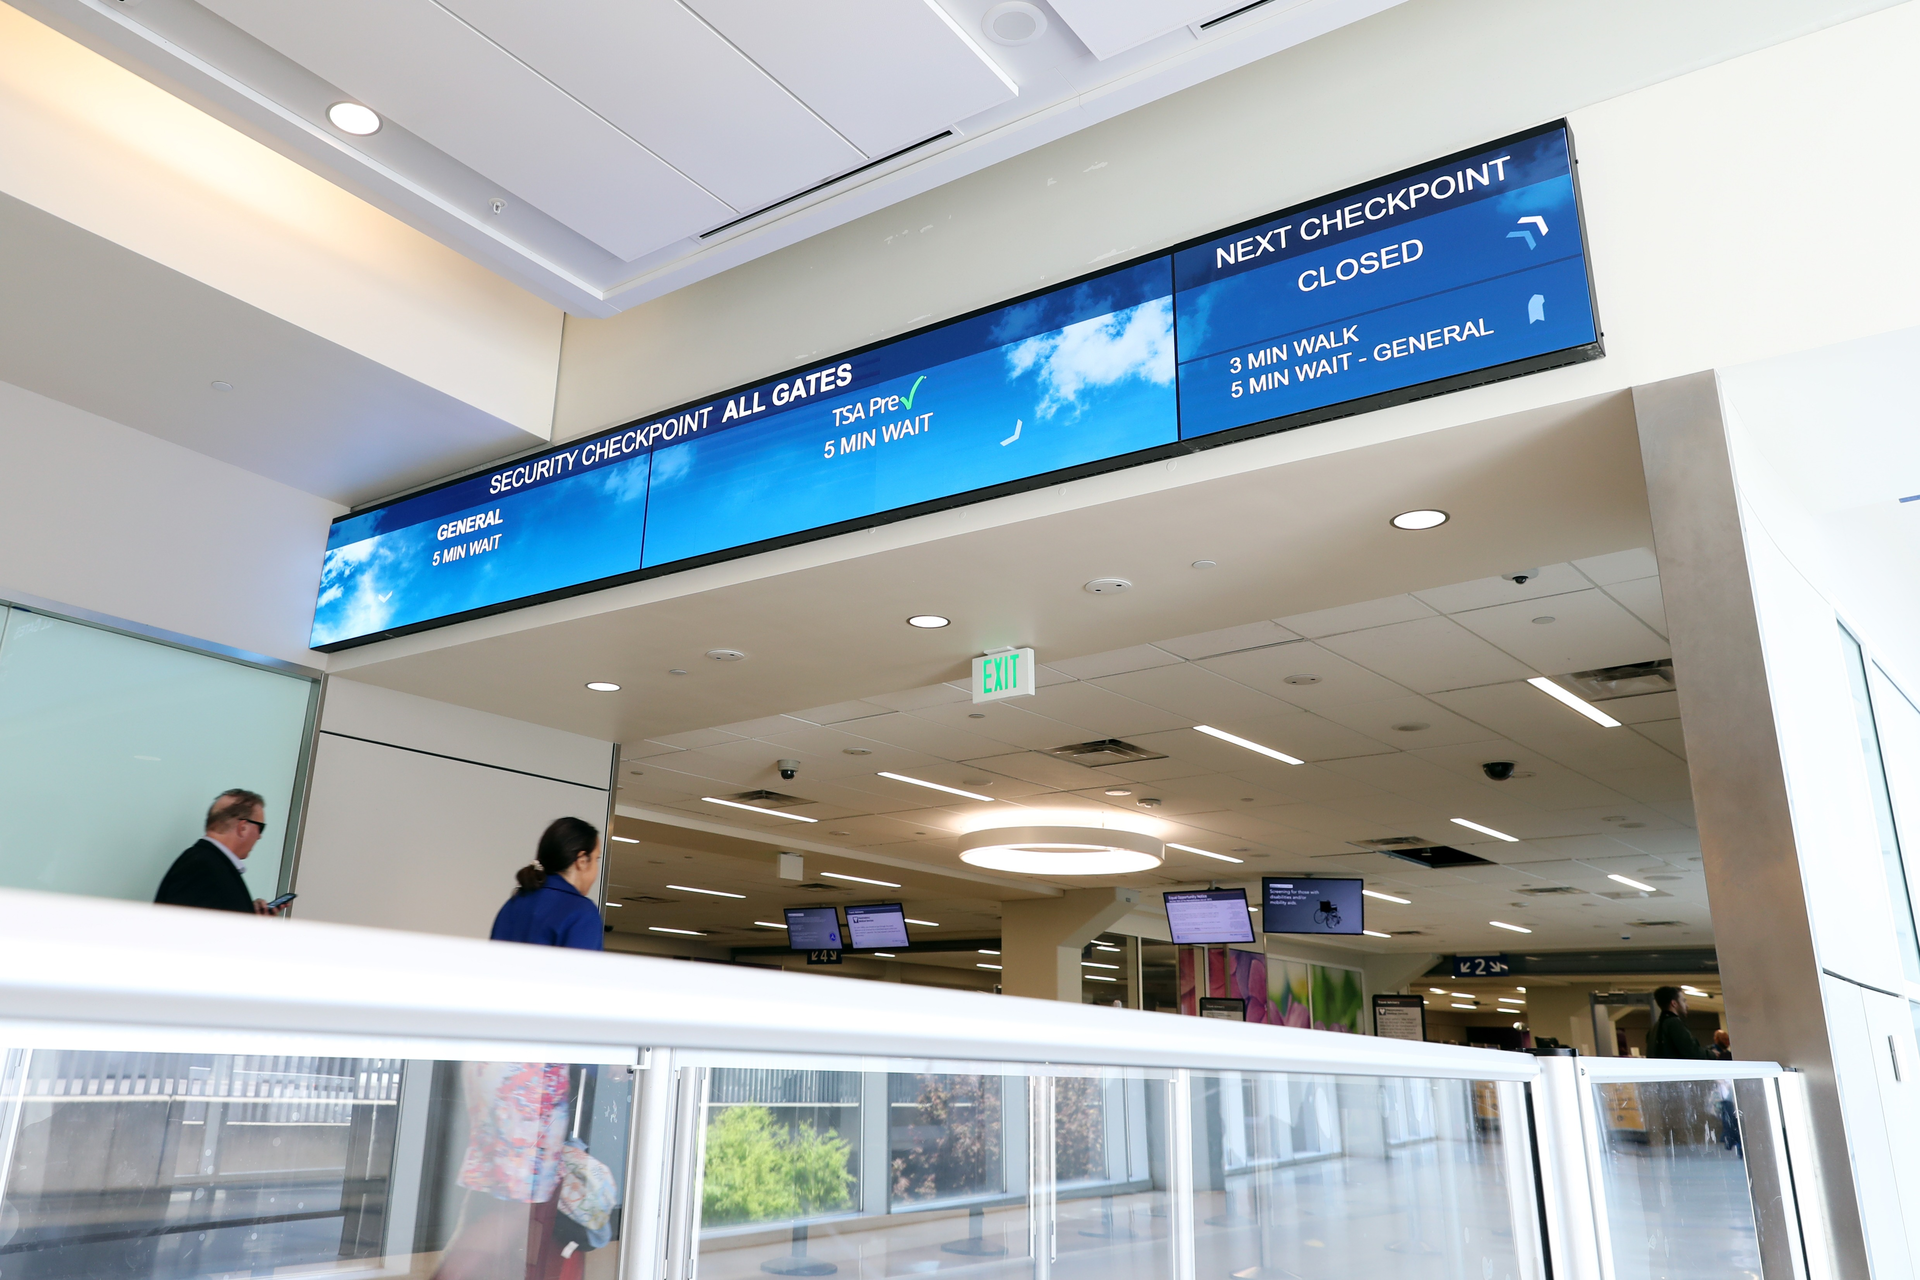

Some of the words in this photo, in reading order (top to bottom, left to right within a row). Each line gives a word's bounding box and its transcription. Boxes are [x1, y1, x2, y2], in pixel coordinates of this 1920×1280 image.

[1216, 225, 1292, 269] NEXT
[1299, 155, 1511, 241] CHECKPOINT
[1297, 239, 1424, 292] CLOSED
[1229, 357, 1242, 374] 3
[1247, 343, 1288, 370] MIN
[1293, 324, 1360, 355] WALK
[1230, 380, 1244, 399] 5
[1248, 368, 1290, 395] MIN
[1295, 351, 1353, 383] WAIT
[1373, 317, 1495, 362] GENERAL
[489, 449, 579, 496] SECURITY
[581, 406, 714, 467] CHECKPOINT
[721, 391, 766, 423] ALL
[772, 362, 853, 407] GATES
[832, 402, 866, 427] TSA
[869, 394, 900, 418] Pre
[823, 440, 836, 459] 5
[840, 428, 876, 455] MIN
[882, 412, 934, 443] WAIT
[437, 508, 504, 541] GENERAL
[432, 550, 441, 567] 5
[442, 543, 467, 564] MIN
[469, 533, 503, 557] WAIT
[982, 653, 1019, 694] EXIT
[820, 950, 828, 962] 4
[1474, 958, 1487, 975] 2
